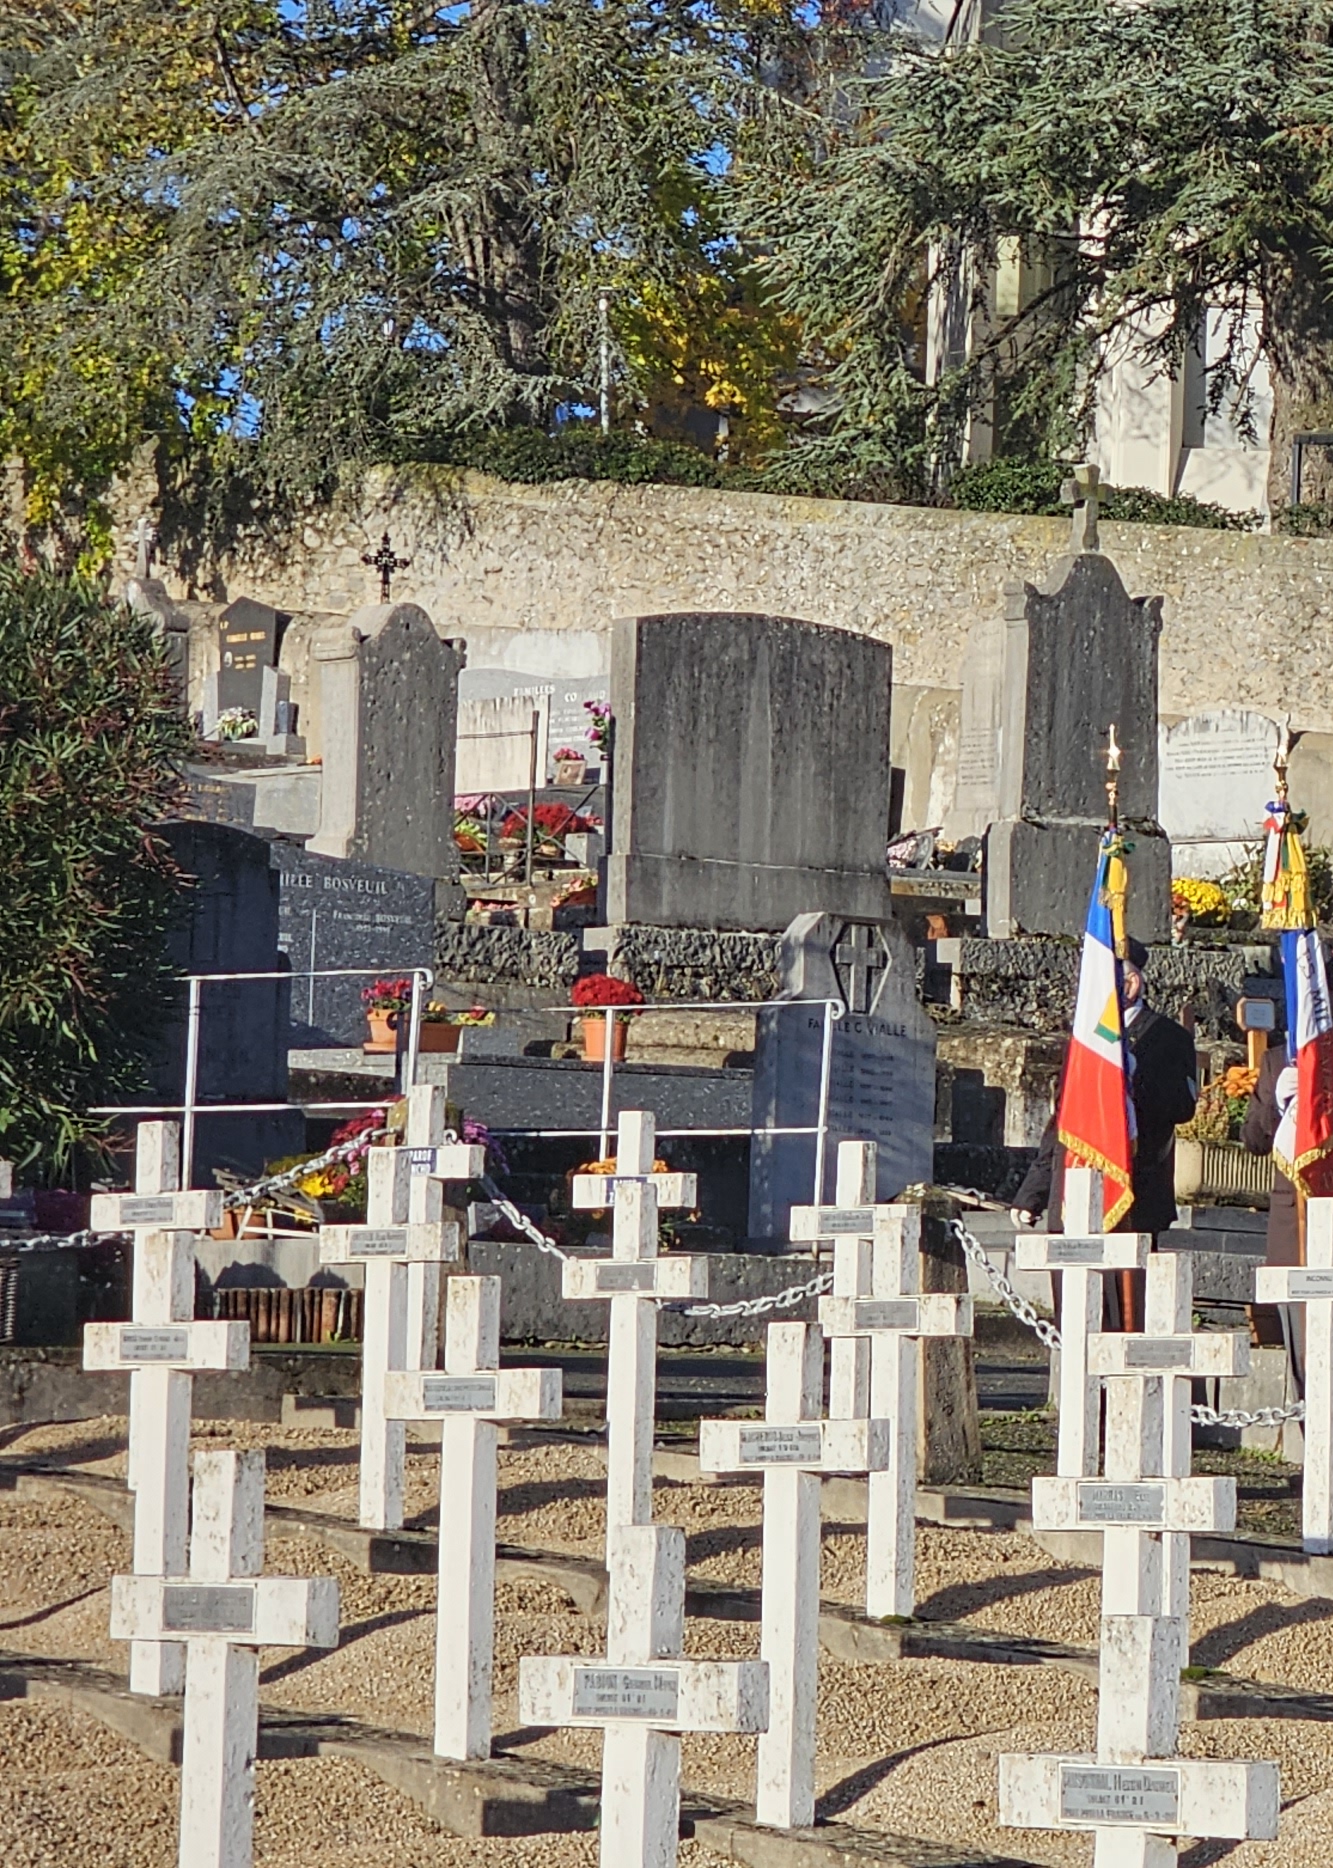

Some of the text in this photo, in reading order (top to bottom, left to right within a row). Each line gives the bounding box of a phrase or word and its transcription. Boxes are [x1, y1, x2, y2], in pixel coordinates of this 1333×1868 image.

[323, 876, 388, 895] BOSVEUIL
[808, 1018, 851, 1033] FALLE
[866, 1023, 907, 1037] VIALLE
